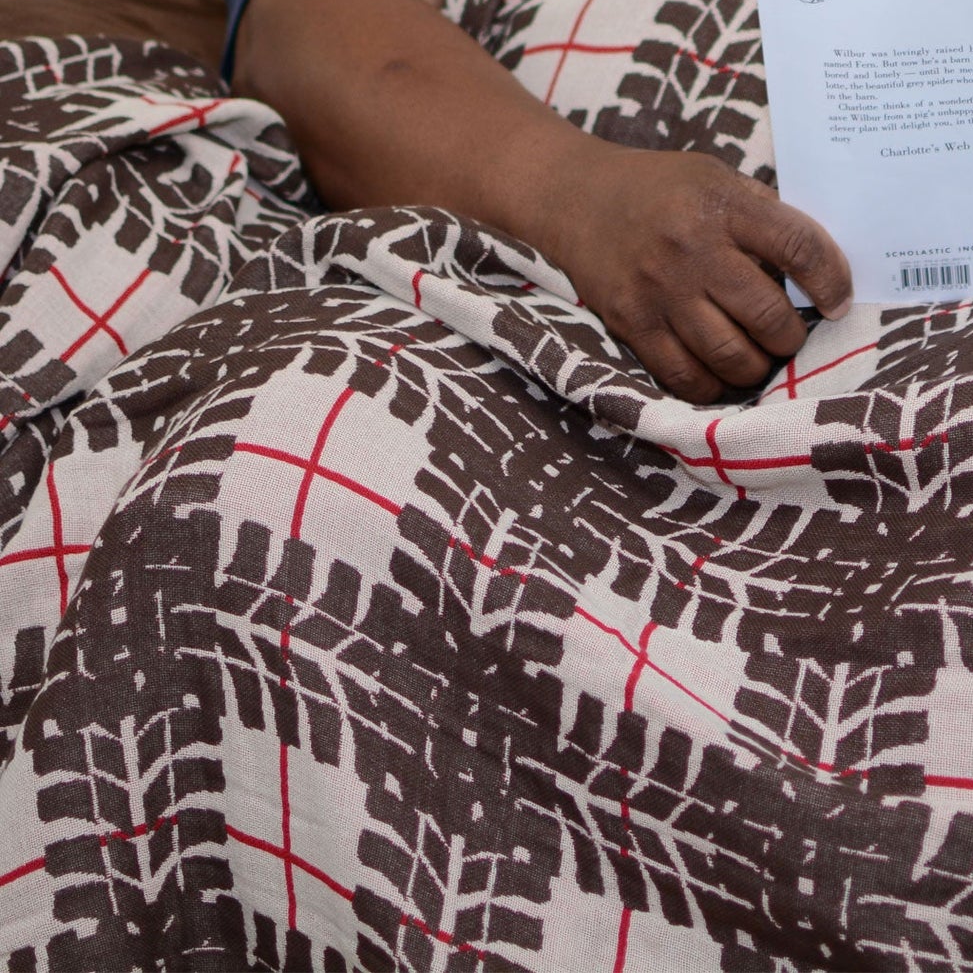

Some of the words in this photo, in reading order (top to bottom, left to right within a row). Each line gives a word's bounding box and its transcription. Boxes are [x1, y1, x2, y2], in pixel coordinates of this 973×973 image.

[834, 49, 865, 58] Wilbur
[893, 47, 929, 57] lovingly
[936, 45, 964, 54] raised
[882, 60, 898, 68] But
[950, 56, 970, 64] barn
[825, 82, 848, 90] lotte,
[850, 82, 864, 90] the
[865, 80, 904, 90] beautiful
[906, 80, 924, 88] grey
[927, 77, 956, 87] spider
[956, 76, 973, 84] who
[855, 92, 878, 100] barn.
[838, 103, 879, 111] Charlotte
[883, 101, 910, 110] thinks
[858, 124, 878, 134] plan
[900, 121, 930, 130] delight
[880, 143, 940, 158] Charlotte's
[944, 140, 971, 152] Web
[885, 247, 952, 258] SCHOLASTIC
